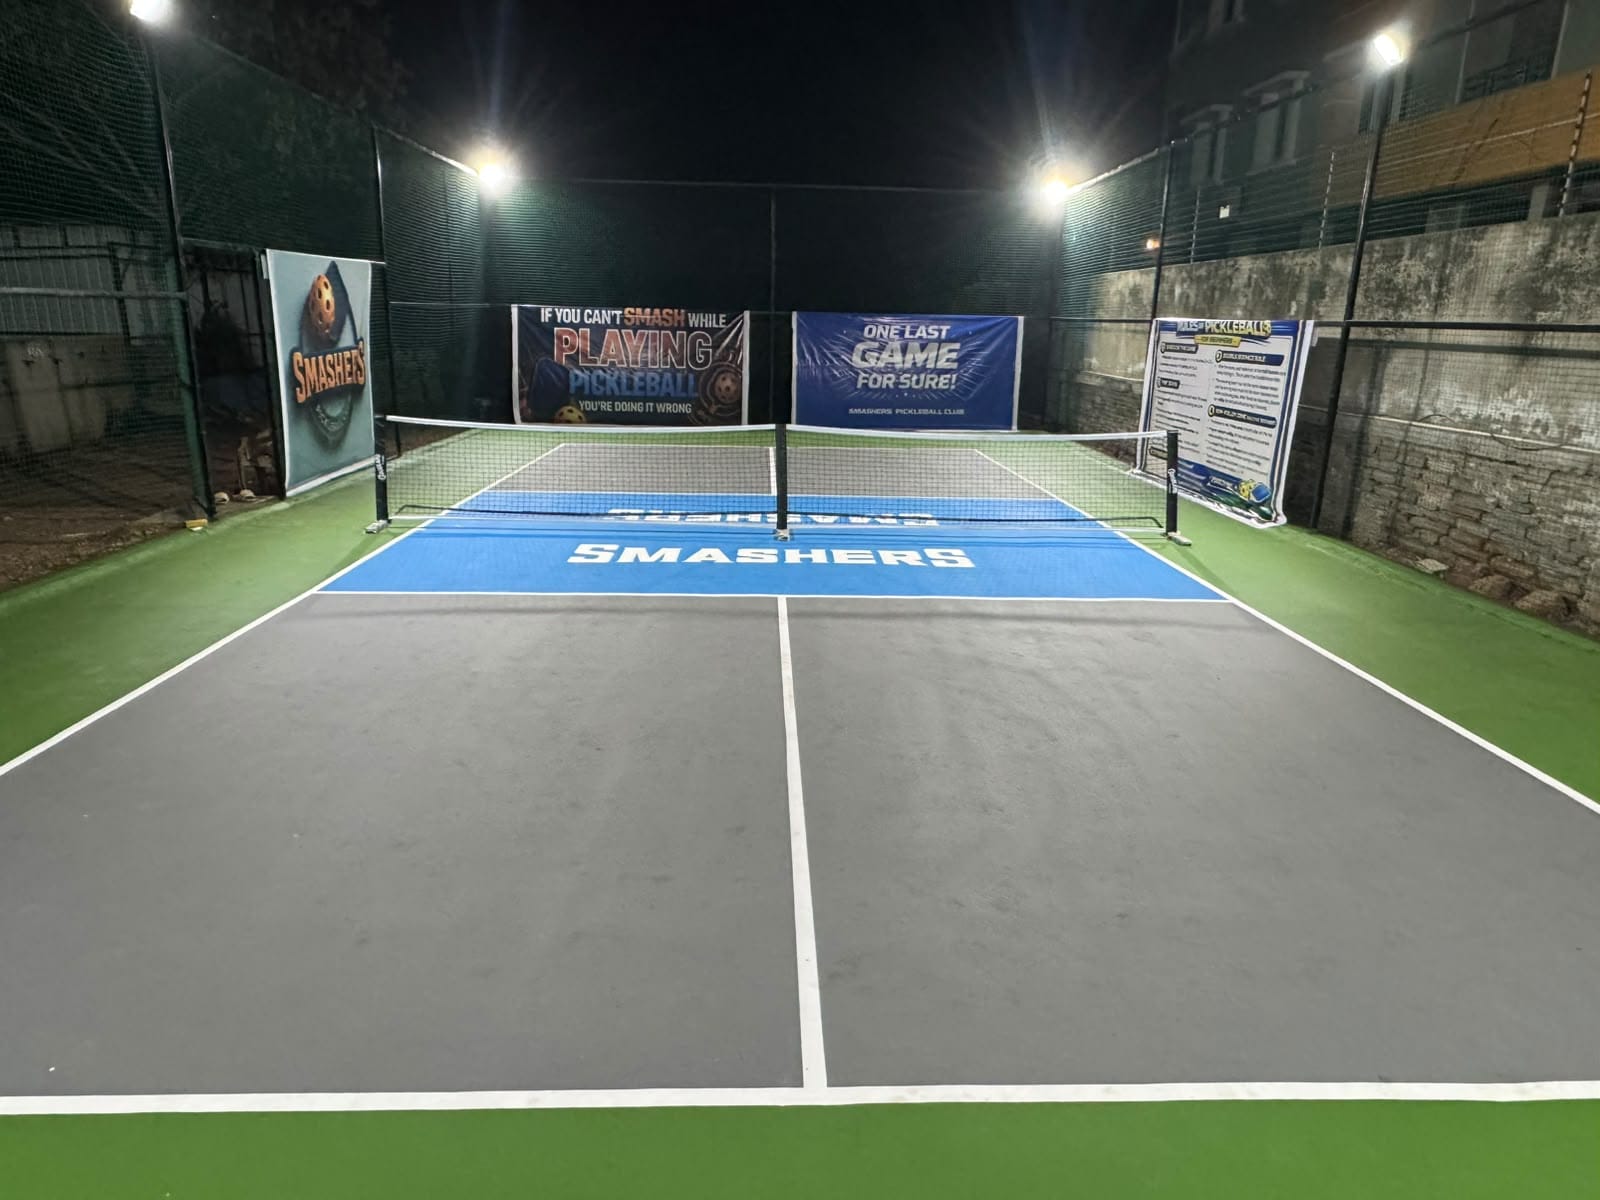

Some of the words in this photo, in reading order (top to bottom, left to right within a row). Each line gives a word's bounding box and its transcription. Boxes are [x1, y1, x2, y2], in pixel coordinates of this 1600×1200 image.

[540, 307, 553, 323] IF
[555, 308, 581, 324] YOU
[589, 309, 622, 326] CAN'T
[623, 307, 686, 327] SMASH
[688, 312, 727, 328] WHILE
[863, 324, 900, 339] ONE
[903, 324, 951, 340] LAST
[554, 327, 713, 371] PLAYING
[851, 341, 961, 370] GAME
[569, 369, 699, 398] PICKLEBALL
[856, 373, 896, 389] FOR
[898, 373, 958, 390] SURE!
[579, 400, 613, 413] YOU'RE
[615, 401, 644, 413] DOING
[646, 402, 654, 413] IT
[656, 402, 692, 414] WRONG
[848, 408, 893, 416] SMASHERS
[895, 408, 942, 416] PICKLEBALL
[943, 408, 965, 416] CLUB
[567, 543, 977, 568] SMASHERS
